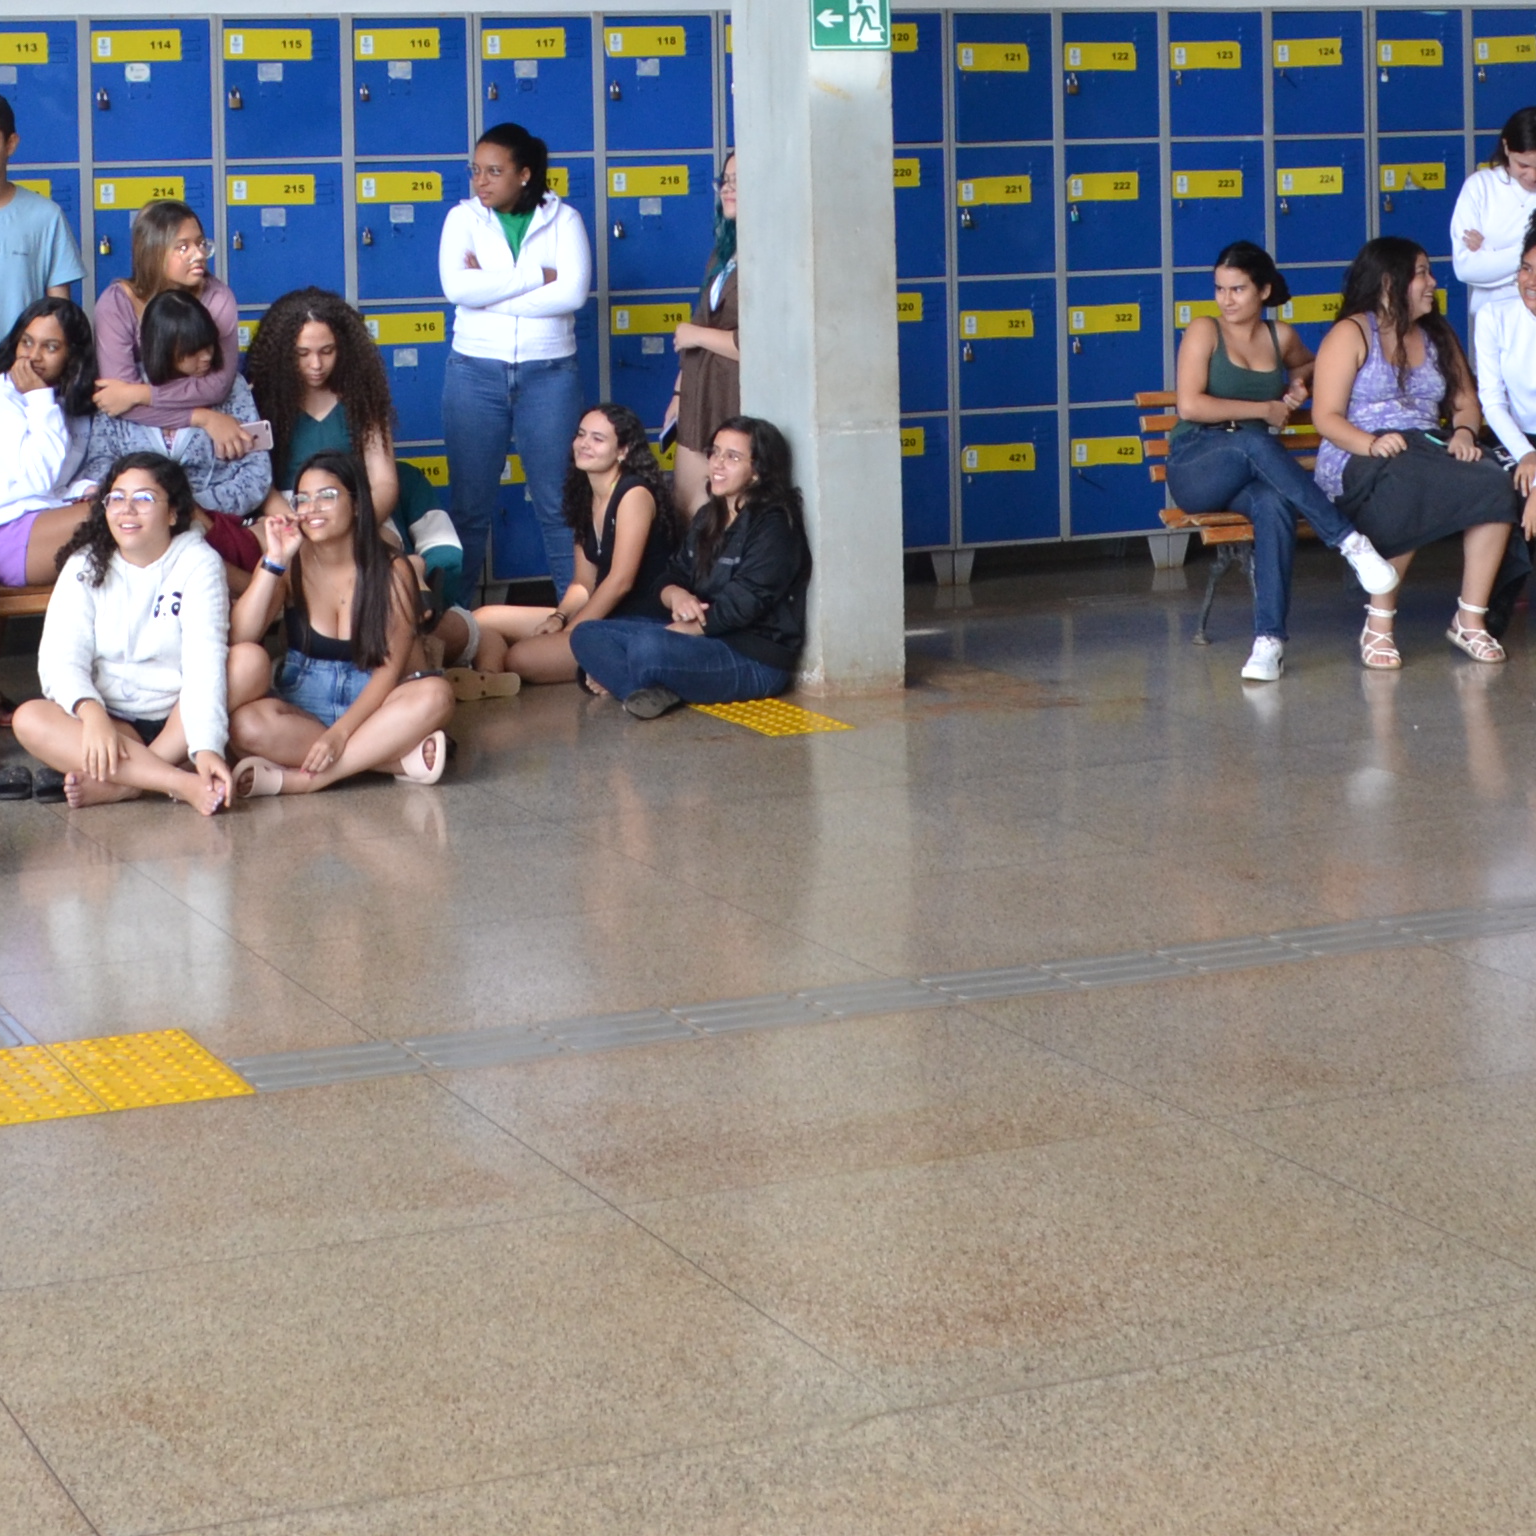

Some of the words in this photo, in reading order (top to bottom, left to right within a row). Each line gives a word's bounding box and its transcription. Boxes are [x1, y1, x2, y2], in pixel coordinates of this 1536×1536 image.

[149, 40, 172, 50] 114
[280, 39, 303, 49] 115
[409, 38, 431, 48] 116
[535, 38, 556, 48] 117
[656, 36, 677, 46] 118
[14, 42, 38, 53] 113
[1318, 47, 1335, 57] 124
[1420, 47, 1436, 57] 125
[1515, 44, 1532, 54] 126
[1004, 52, 1021, 62] 121
[1111, 51, 1129, 61] 122
[1216, 50, 1234, 60] 123
[893, 168, 912, 178] 220
[1422, 172, 1439, 182] 225
[660, 175, 680, 186] 218
[1217, 178, 1236, 188] 223
[1319, 174, 1335, 184] 224
[283, 184, 306, 194] 215
[411, 181, 433, 191] 216
[1005, 184, 1023, 195] 221
[1113, 181, 1131, 191] 222
[153, 188, 175, 197] 214
[663, 312, 683, 323] 318
[1115, 313, 1133, 323] 322
[415, 322, 436, 332] 316
[1008, 319, 1026, 329] 321
[1116, 446, 1135, 456] 422
[1008, 453, 1027, 463] 421
